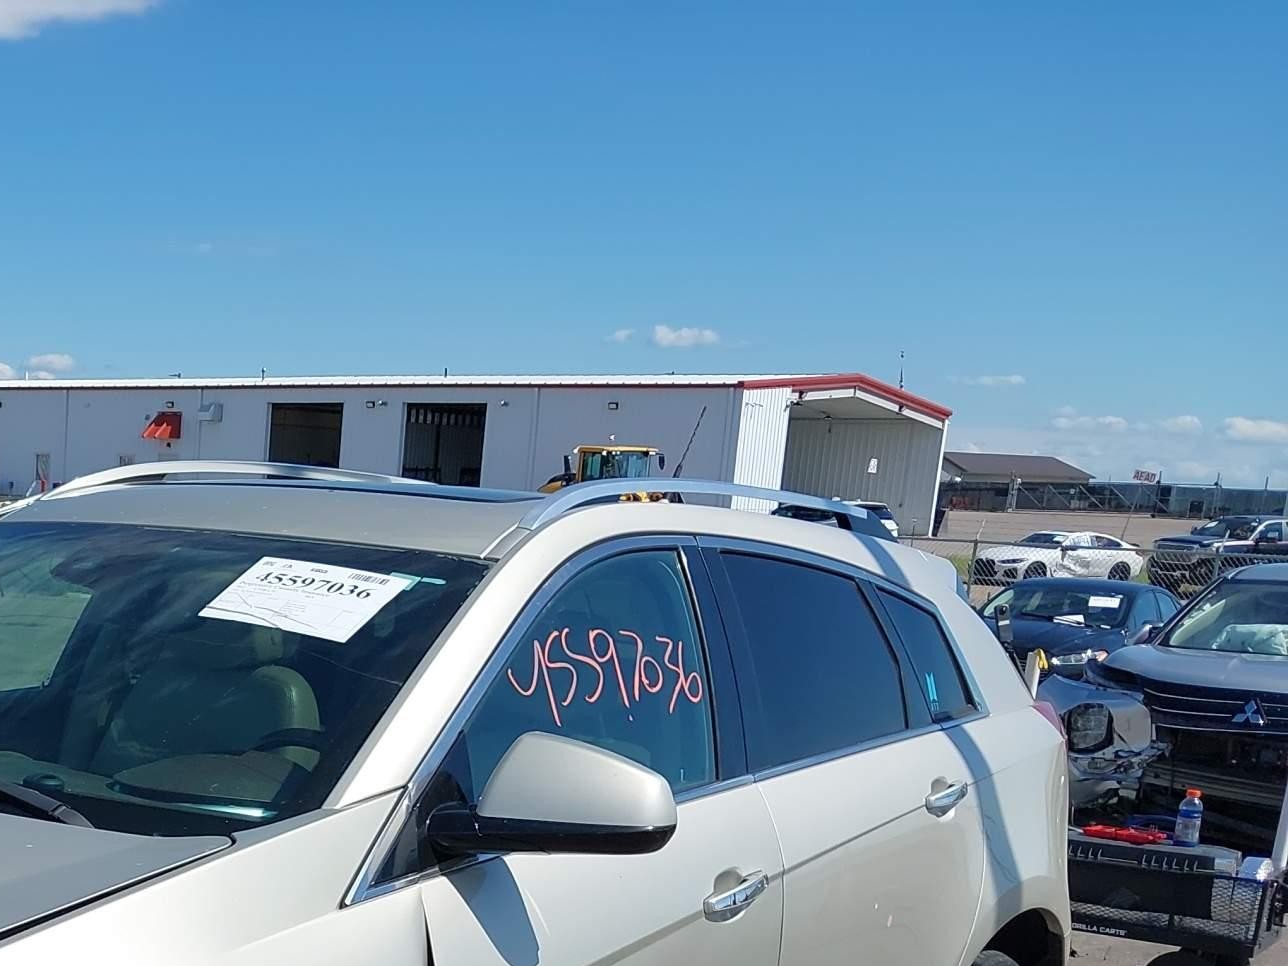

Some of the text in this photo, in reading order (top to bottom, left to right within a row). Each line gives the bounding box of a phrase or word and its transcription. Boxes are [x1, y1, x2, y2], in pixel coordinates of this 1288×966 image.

[255, 571, 374, 600] 45597036
[507, 628, 703, 727] 45597036
[1071, 923, 1098, 931] ORILLA
